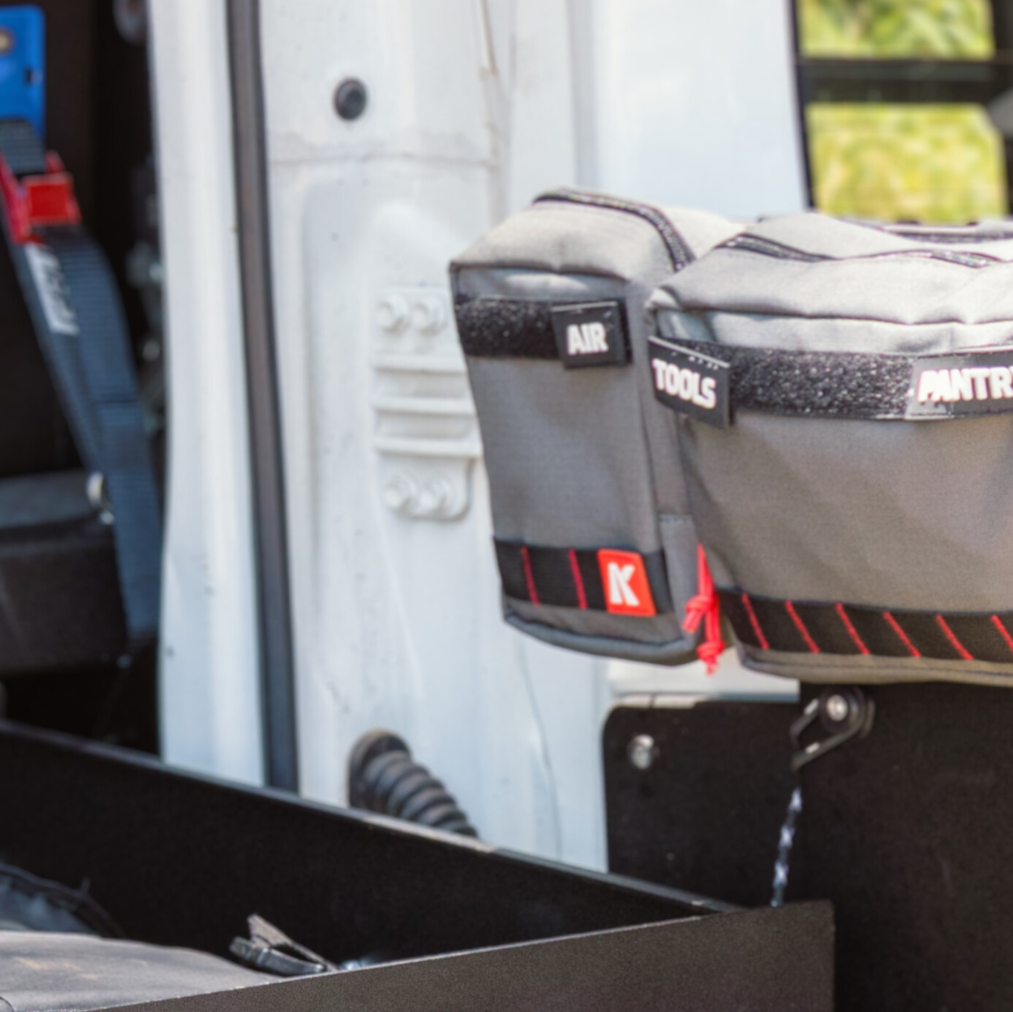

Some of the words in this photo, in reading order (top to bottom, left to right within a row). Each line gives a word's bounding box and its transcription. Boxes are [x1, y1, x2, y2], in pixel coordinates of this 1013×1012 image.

[567, 322, 609, 355] AIR
[652, 357, 716, 409] TOOLS
[607, 563, 639, 606] K
